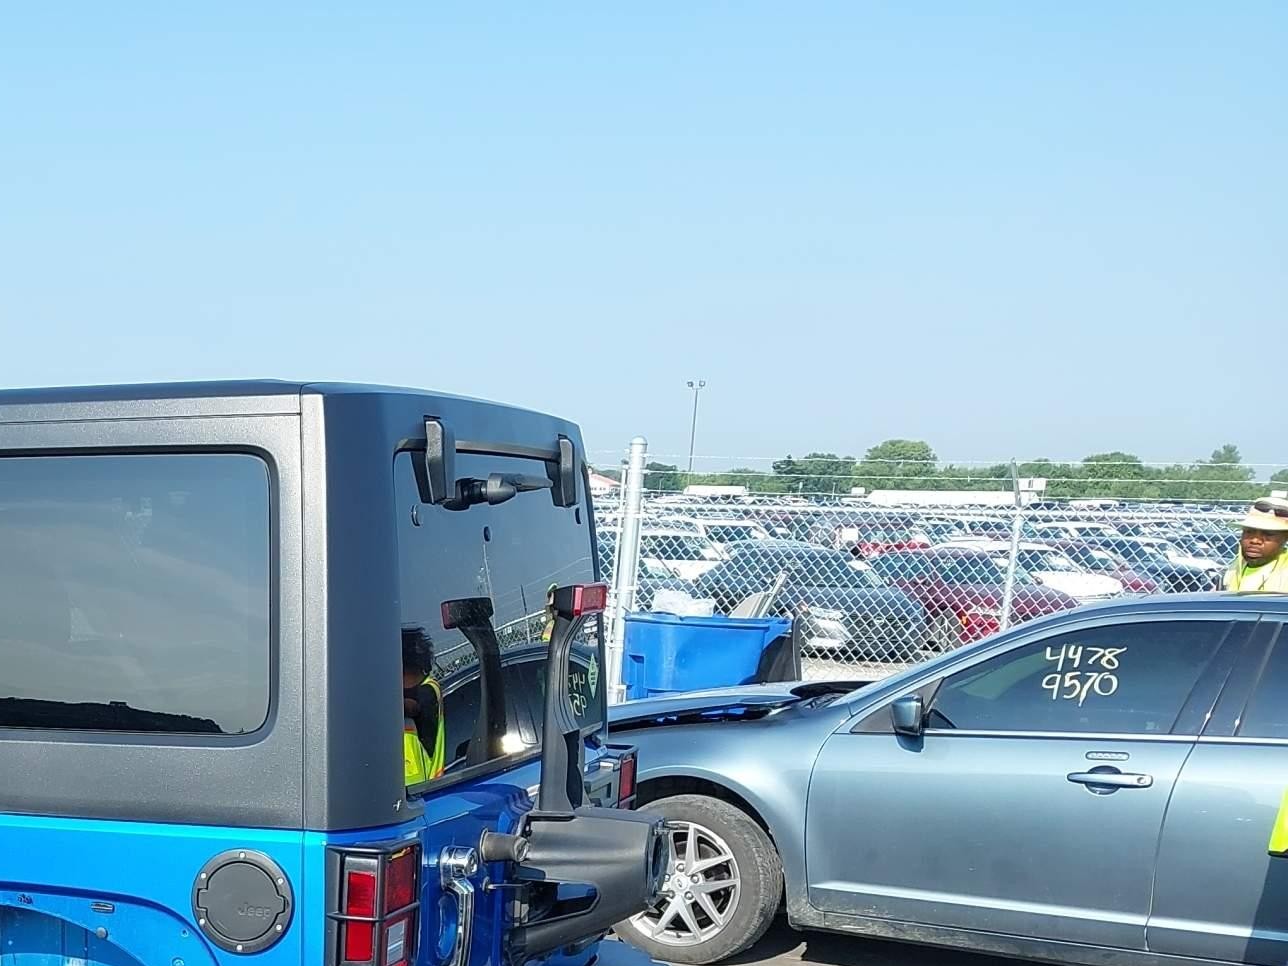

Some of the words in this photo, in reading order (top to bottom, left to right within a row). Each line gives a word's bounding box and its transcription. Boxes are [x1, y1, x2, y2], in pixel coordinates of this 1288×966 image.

[1045, 643, 1127, 671] 4478
[1041, 671, 1118, 708] 9570
[238, 902, 272, 921] Jeep
